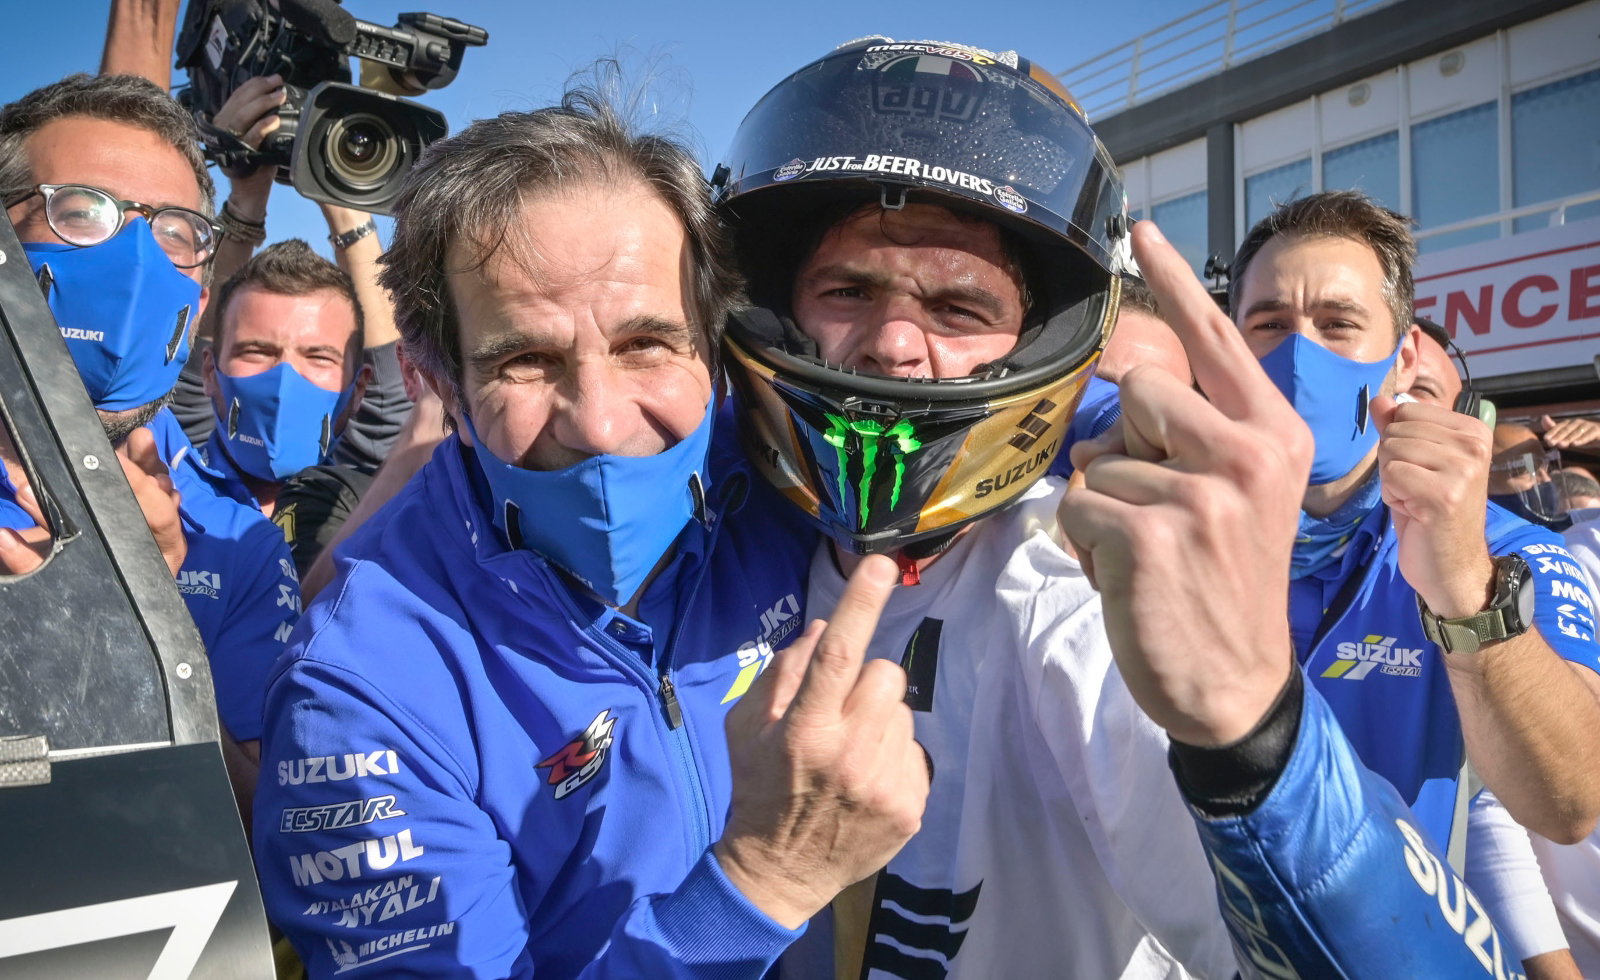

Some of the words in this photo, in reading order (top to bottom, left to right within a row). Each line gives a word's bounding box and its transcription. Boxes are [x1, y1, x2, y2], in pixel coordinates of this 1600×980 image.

[805, 156, 856, 172] JUST
[847, 163, 863, 171] FOR
[862, 154, 921, 177] BEER
[922, 164, 993, 196] LOVERS
[59, 326, 104, 342] UZUKI
[974, 437, 1059, 499] SUZUKI
[1336, 642, 1424, 667] SUZUK
[278, 750, 399, 786] SUZUKI
[280, 795, 407, 833] ECSTAR
[289, 828, 423, 887] MOTUL
[303, 875, 413, 916] NYALAKAN
[333, 876, 441, 928] NYALI
[359, 921, 454, 957] MICHELIN
